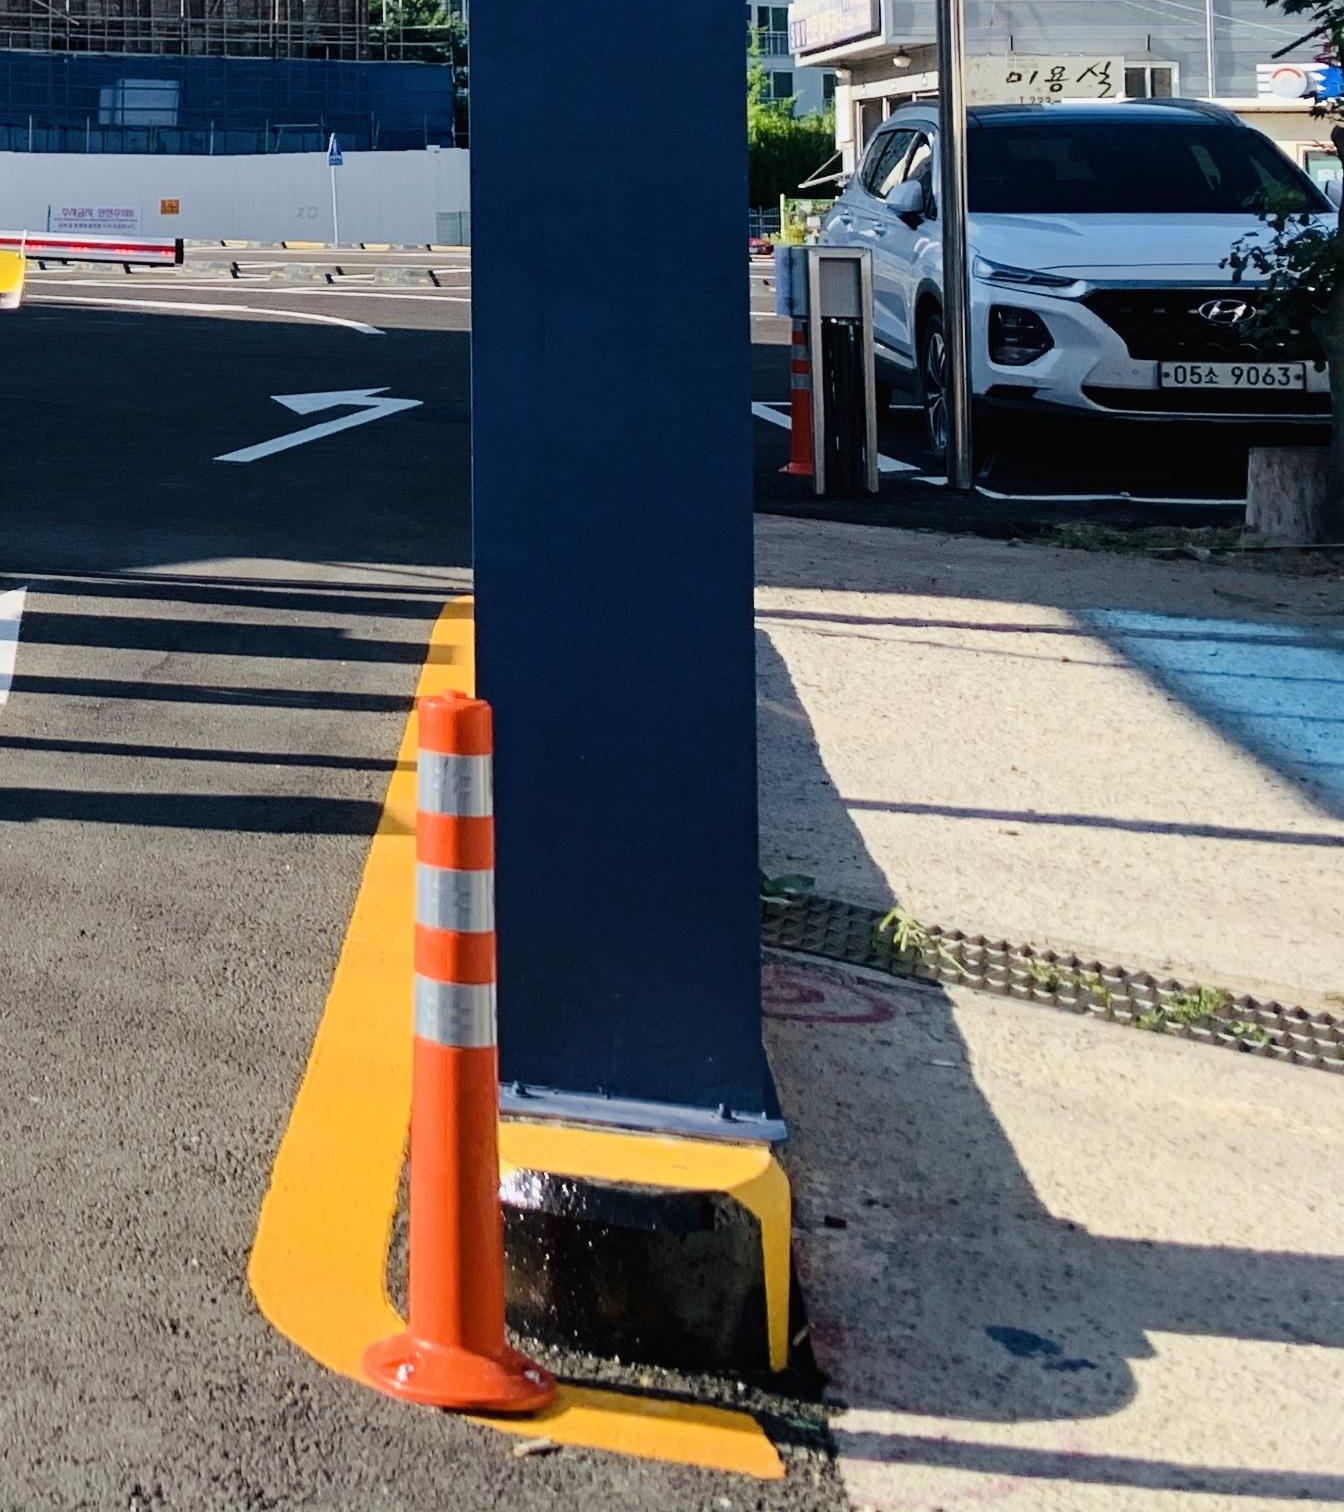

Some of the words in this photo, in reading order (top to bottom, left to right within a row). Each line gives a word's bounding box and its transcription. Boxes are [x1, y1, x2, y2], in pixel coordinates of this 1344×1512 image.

[1006, 61, 1117, 99] 미용실
[1174, 365, 1219, 384] 05소
[1231, 366, 1290, 386] 9063
